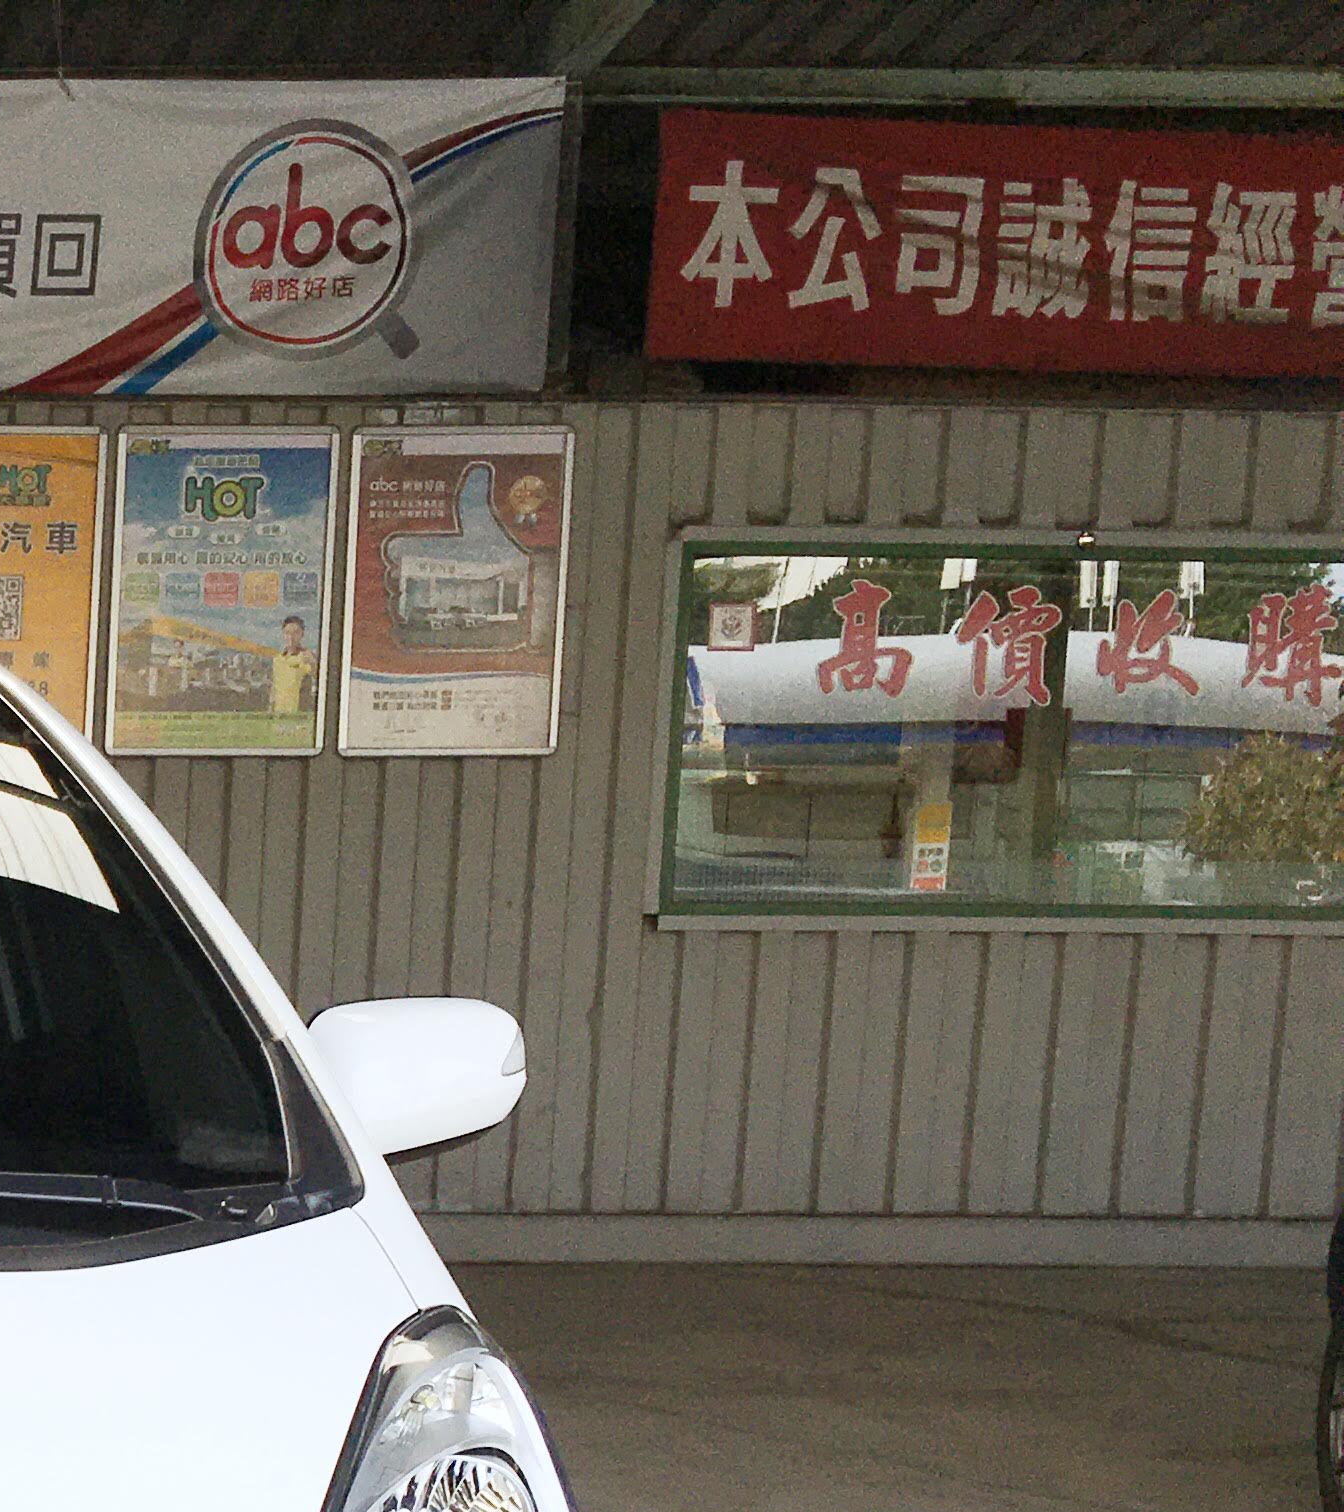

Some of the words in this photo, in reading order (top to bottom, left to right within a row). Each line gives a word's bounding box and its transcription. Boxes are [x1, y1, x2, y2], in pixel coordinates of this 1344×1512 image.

[221, 162, 394, 268] abc
[248, 273, 356, 303] 網路好店
[184, 475, 265, 521] HOT
[369, 475, 399, 492] abc
[815, 578, 1343, 706] 高價收購
